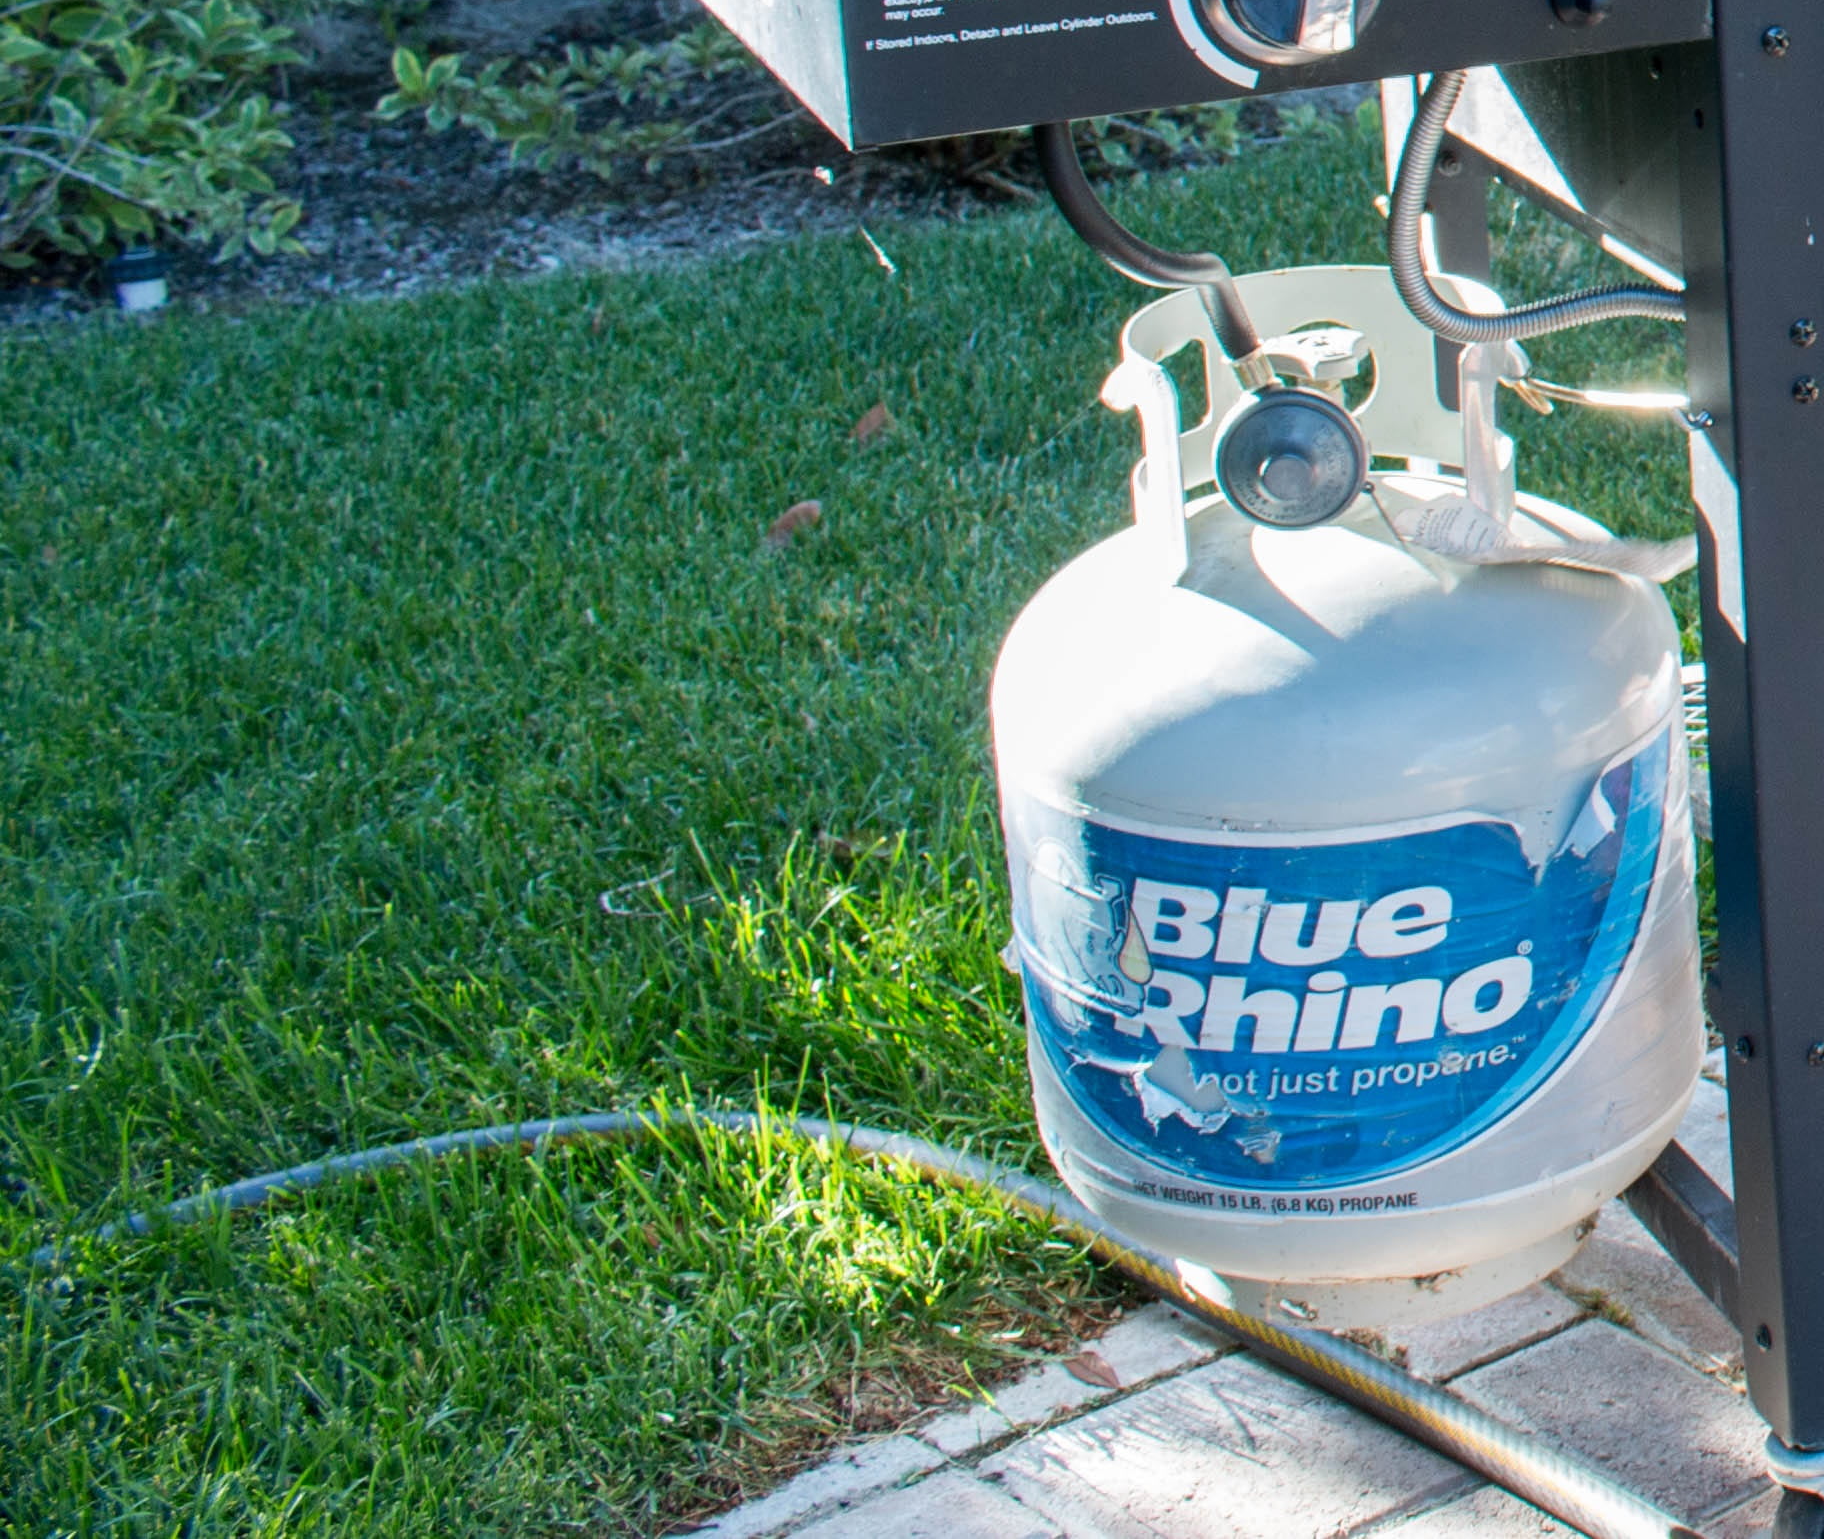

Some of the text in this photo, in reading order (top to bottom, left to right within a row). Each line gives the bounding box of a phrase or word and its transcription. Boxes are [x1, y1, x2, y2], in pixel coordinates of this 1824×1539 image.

[1131, 877, 1453, 966] Blue
[1114, 956, 1533, 1054] Rhino
[1267, 1066, 1339, 1101] just
[1160, 1184, 1214, 1206] WEIGHT
[1219, 1192, 1238, 1209] 15
[1241, 1195, 1266, 1211] LB.
[1271, 1195, 1301, 1213] (6.8
[1306, 1197, 1335, 1214] KG)
[1340, 1192, 1419, 1211] PROPANE
